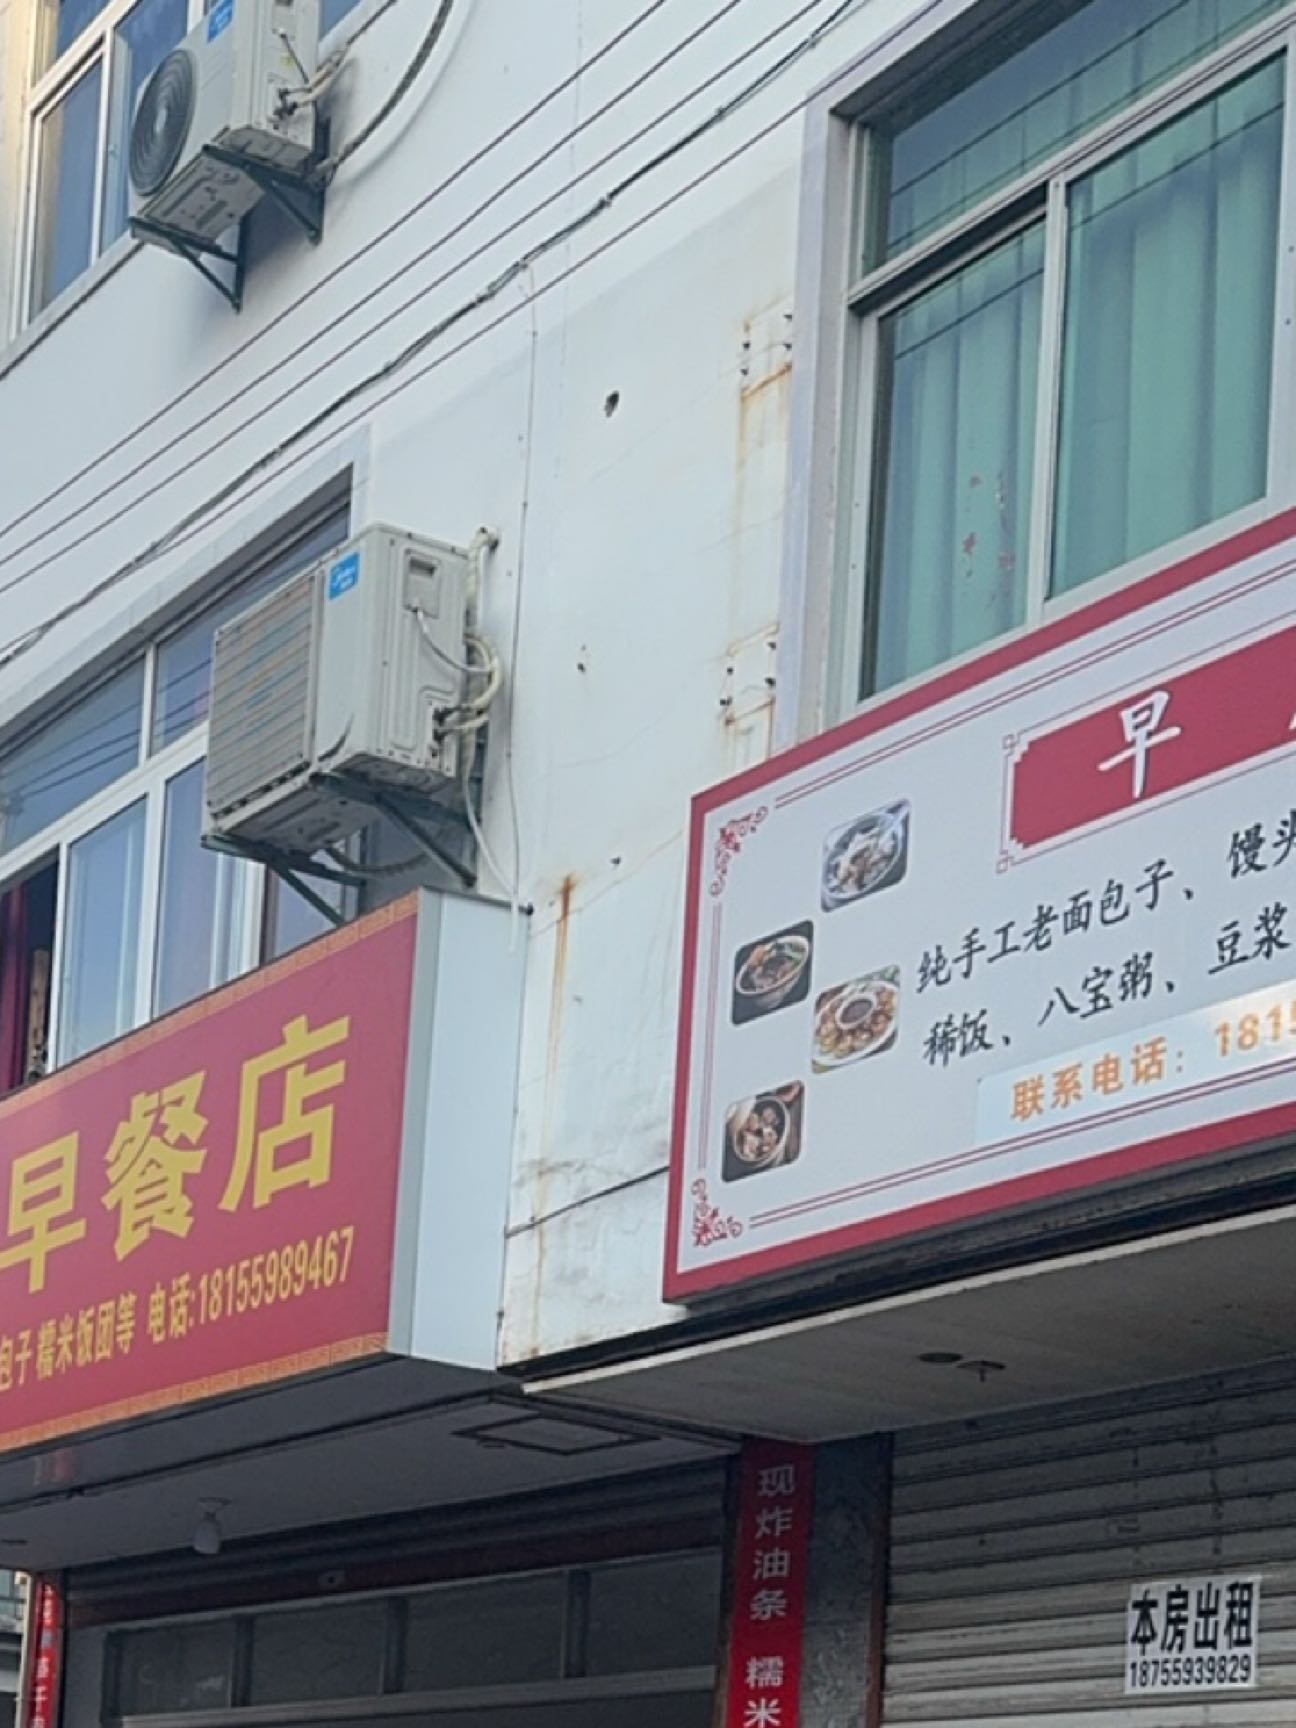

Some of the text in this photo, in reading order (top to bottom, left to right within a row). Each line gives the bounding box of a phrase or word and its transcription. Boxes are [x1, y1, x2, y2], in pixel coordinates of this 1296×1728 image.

[749, 1464, 796, 1622] 现炸油条
[1130, 1581, 1254, 1656] 本房出租
